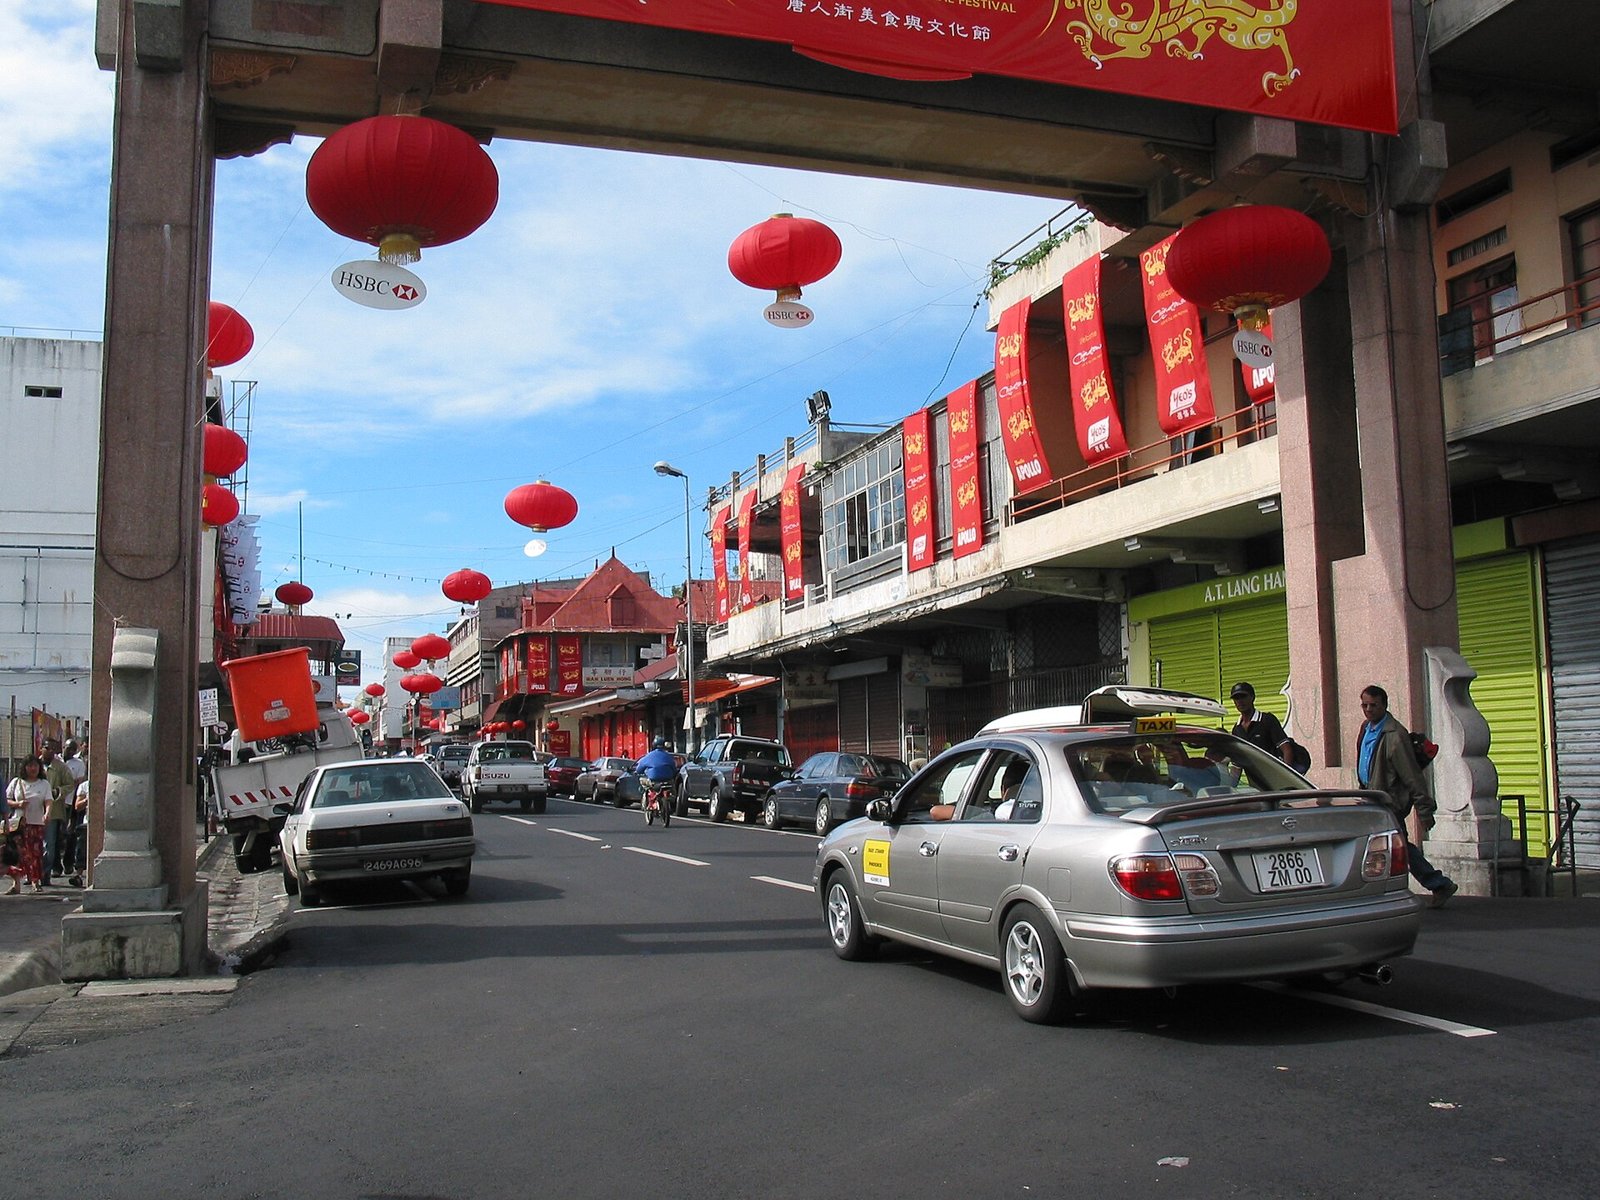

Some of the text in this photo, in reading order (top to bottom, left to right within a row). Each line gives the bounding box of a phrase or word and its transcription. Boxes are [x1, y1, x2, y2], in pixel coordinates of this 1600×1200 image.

[339, 271, 390, 295] HSBC
[767, 311, 795, 320] HSBC
[1237, 340, 1260, 356] HSBC
[1015, 459, 1042, 481] APOLLO
[957, 527, 977, 547] APOLLO
[1204, 584, 1224, 602] A.T.
[1227, 575, 1260, 598] LANG
[1139, 720, 1174, 731] TAXI
[1268, 852, 1304, 871] 2866
[1267, 867, 1313, 887] ZM 00
